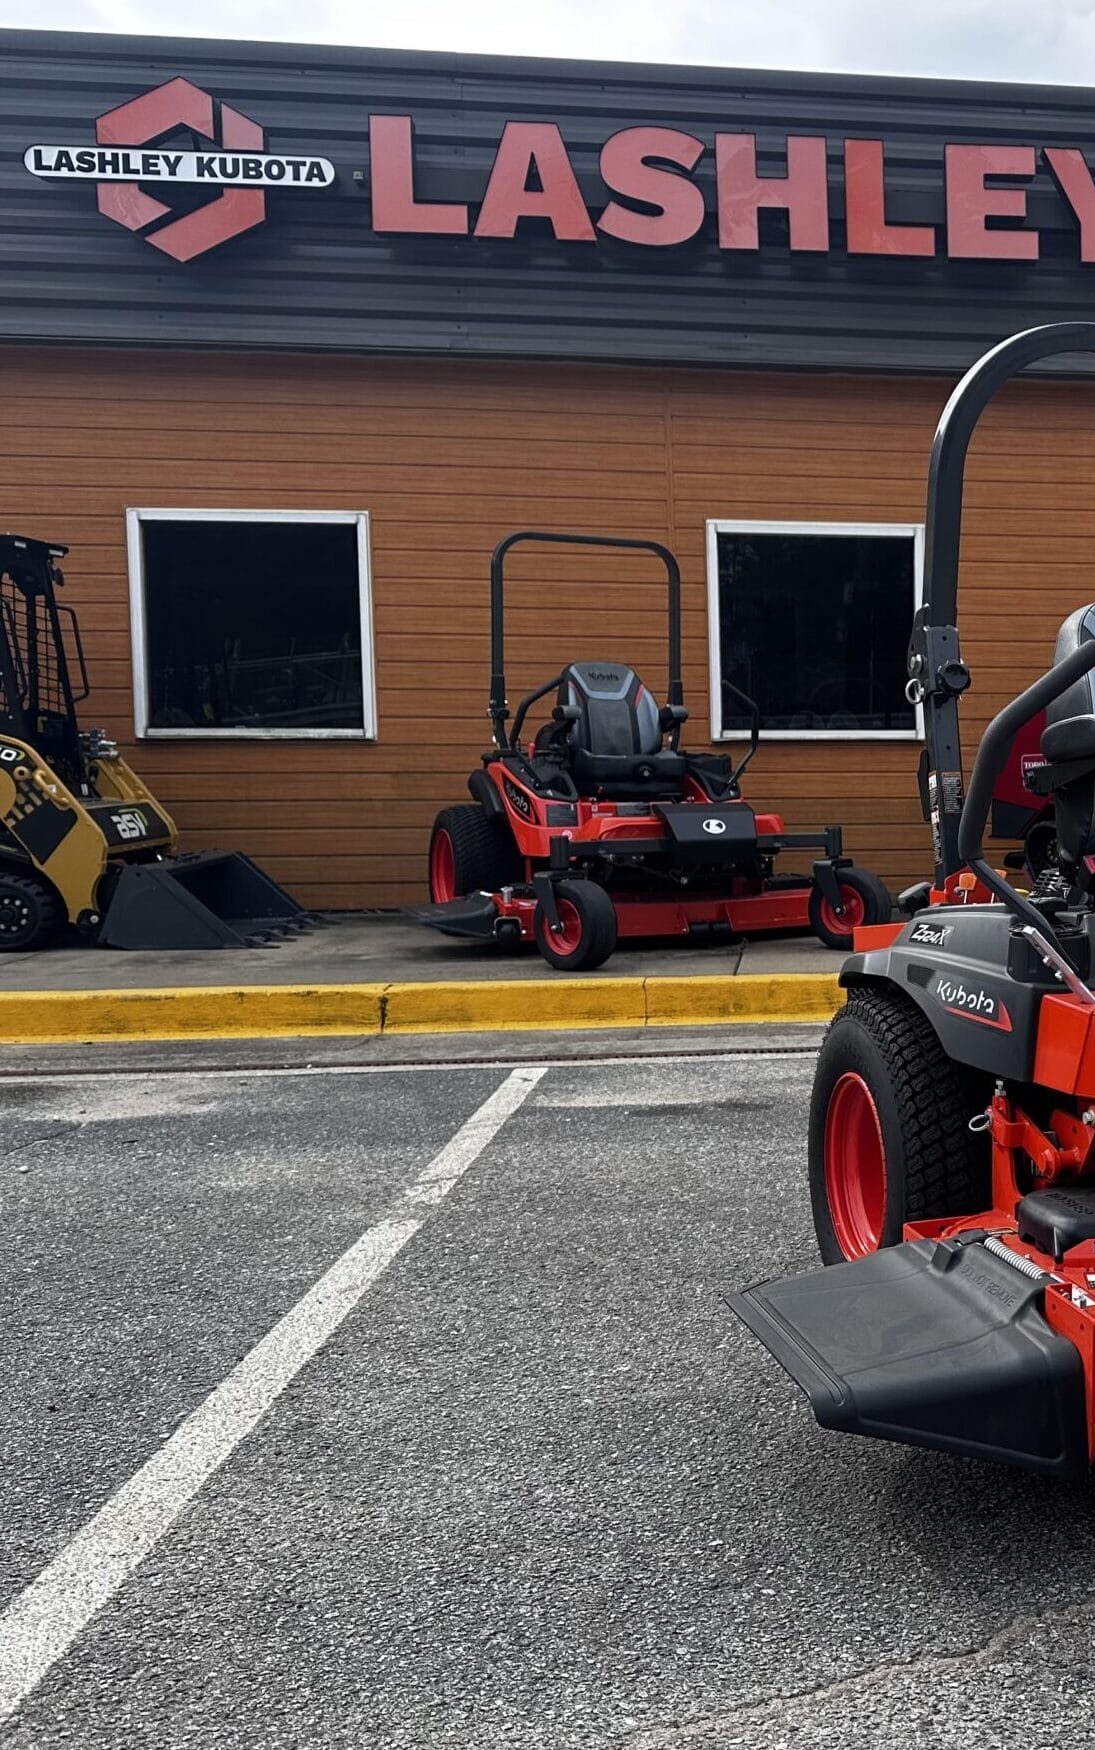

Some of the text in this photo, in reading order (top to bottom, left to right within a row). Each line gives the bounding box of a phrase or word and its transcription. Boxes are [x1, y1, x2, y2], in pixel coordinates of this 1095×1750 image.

[33, 148, 327, 183] LASHLEY KUBOTA
[587, 671, 619, 681] Kubota
[936, 979, 995, 1014] Kubota
